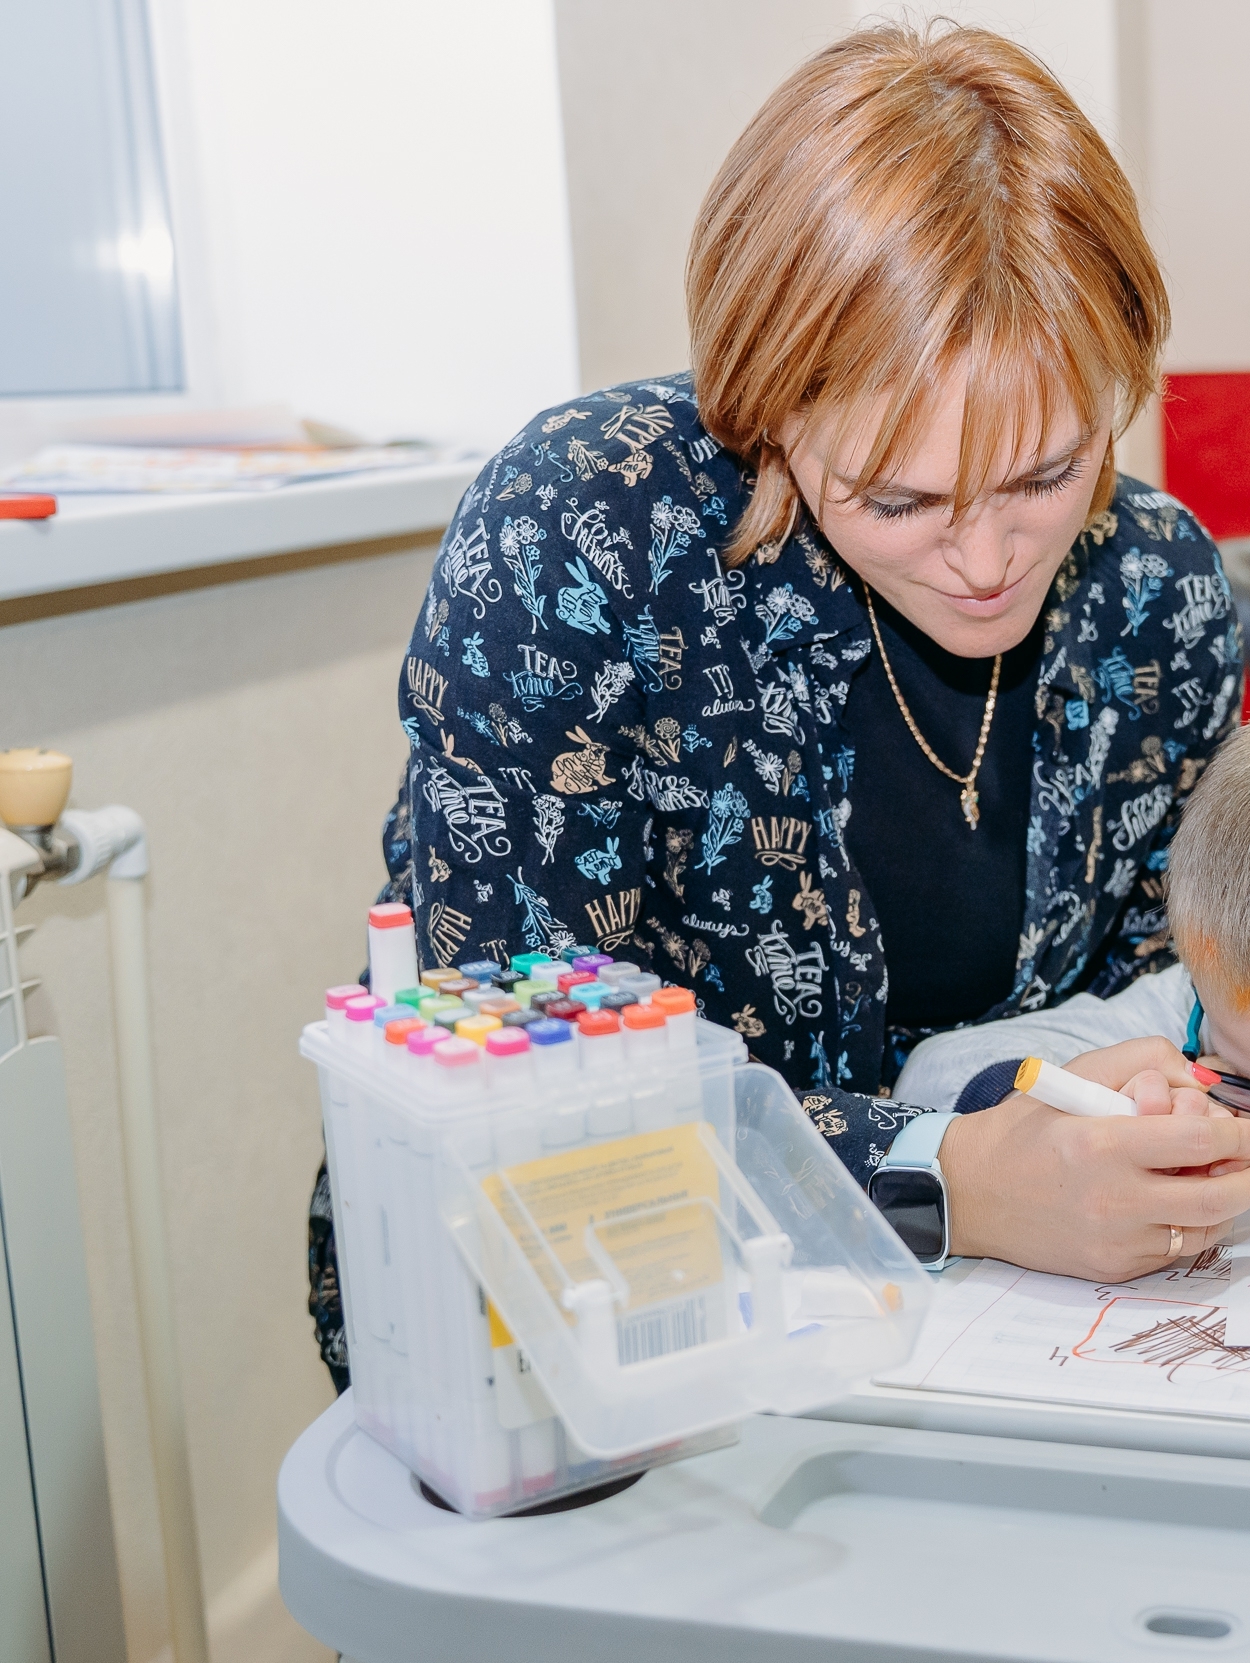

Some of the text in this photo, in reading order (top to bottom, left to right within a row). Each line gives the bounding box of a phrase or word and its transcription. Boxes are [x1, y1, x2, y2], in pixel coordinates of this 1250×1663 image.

[407, 656, 449, 711] HAPPY
[517, 644, 577, 685] TEA
[658, 626, 688, 690] TEA
[464, 775, 511, 856] TEA
[751, 816, 812, 853] HAPPY
[794, 941, 829, 1017] TEA
